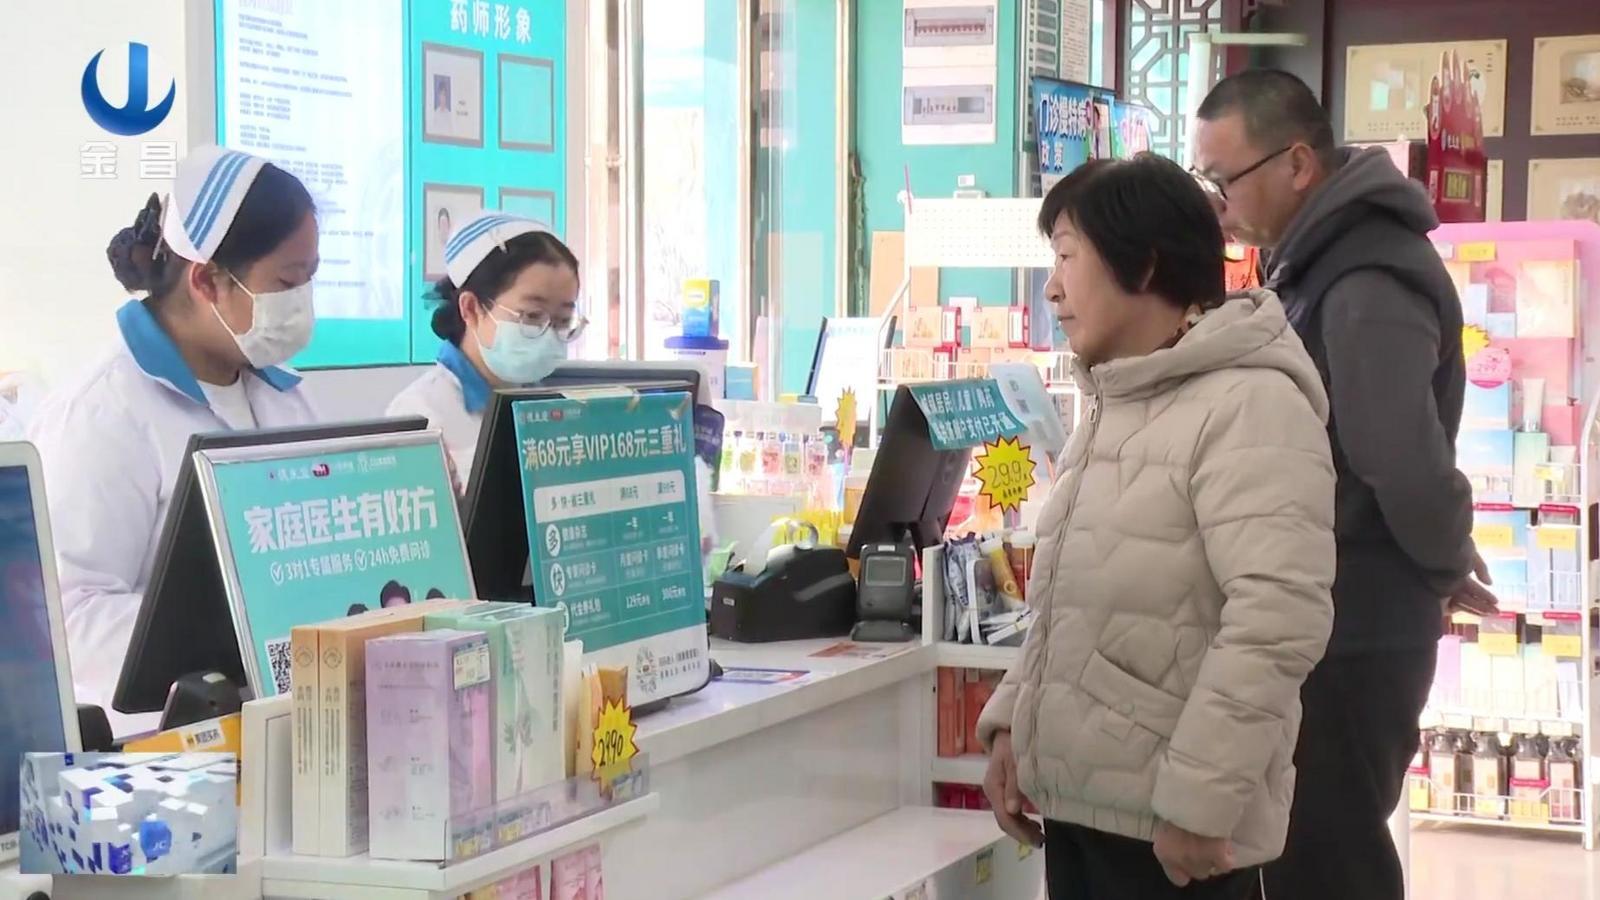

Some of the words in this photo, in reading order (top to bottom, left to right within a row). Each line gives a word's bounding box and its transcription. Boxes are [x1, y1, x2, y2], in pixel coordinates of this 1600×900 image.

[450, 0, 532, 44] 药师形象
[522, 424, 686, 470] 满68元享VIP168元三重礼
[244, 485, 438, 554] 家庭医生有好方
[369, 540, 431, 569] 24h免费问诊
